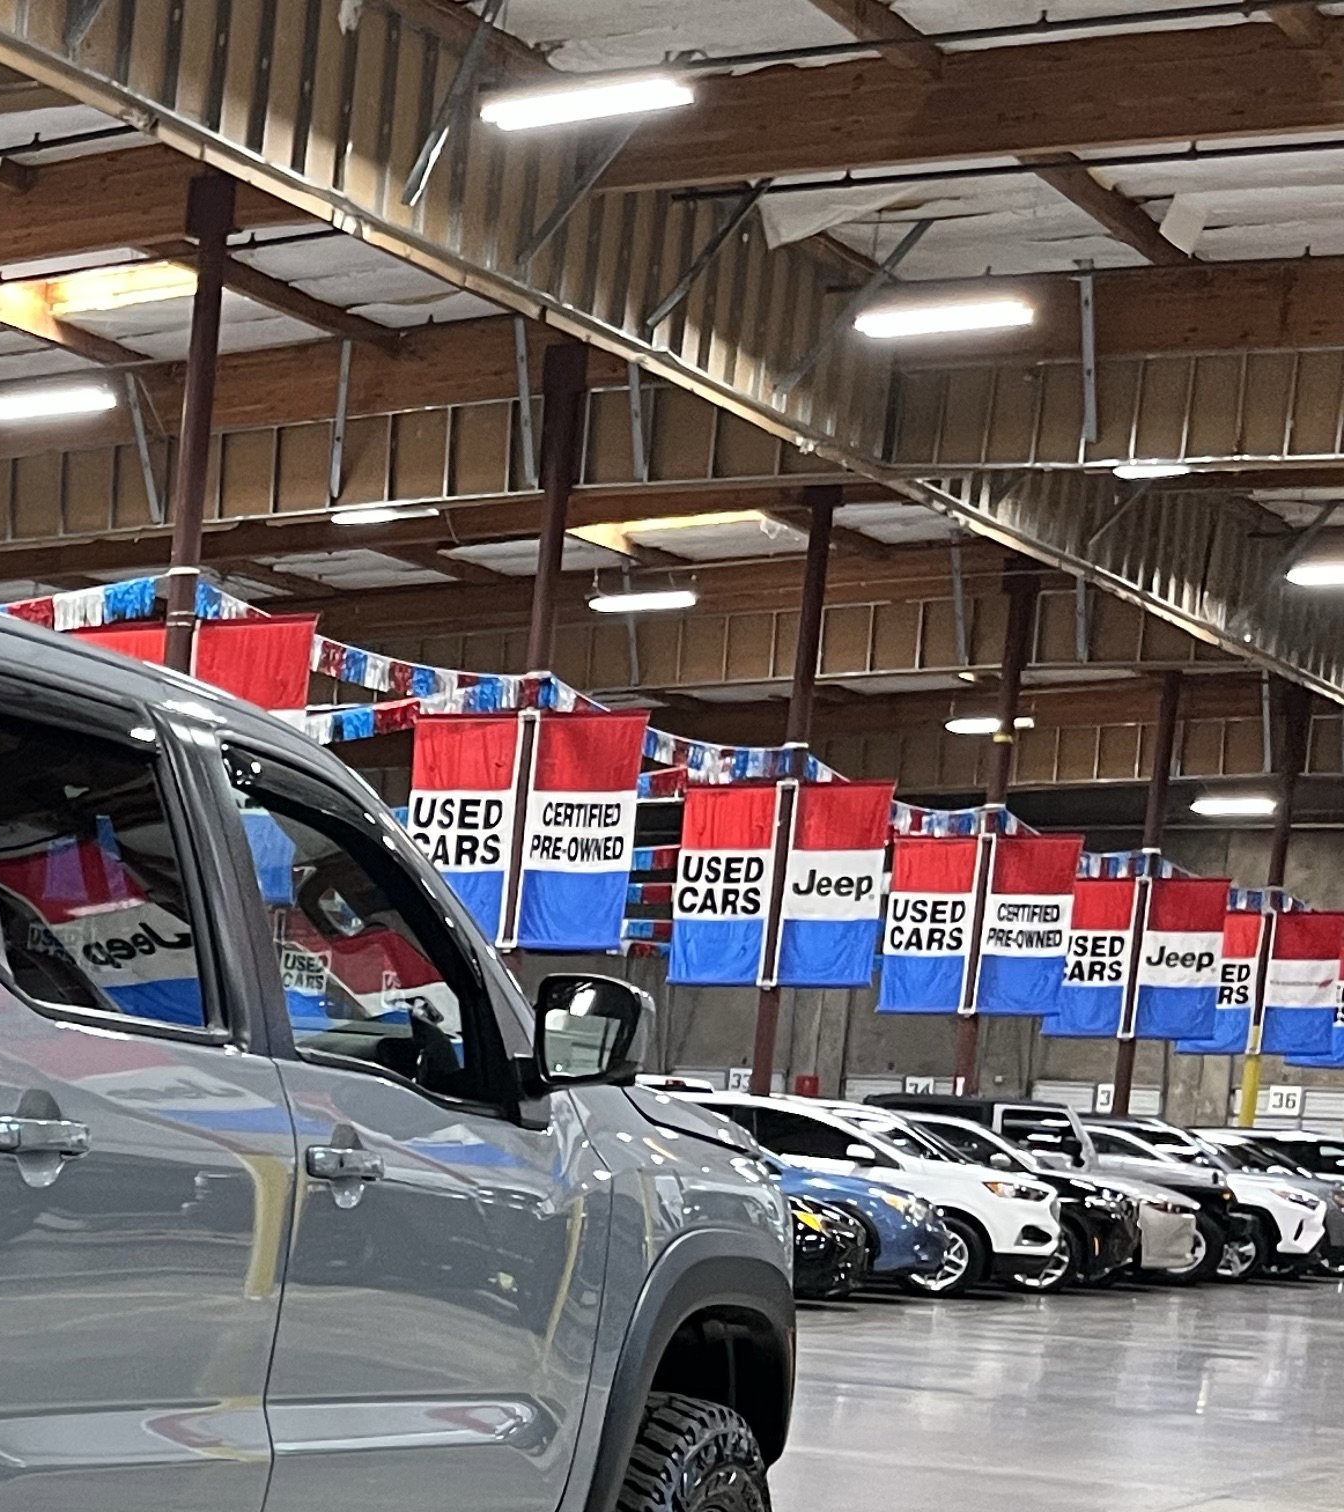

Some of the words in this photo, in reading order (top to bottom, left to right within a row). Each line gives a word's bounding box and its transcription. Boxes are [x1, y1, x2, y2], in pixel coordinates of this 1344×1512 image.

[413, 797, 503, 830] USED
[542, 802, 622, 827] CERTIFIED
[412, 832, 501, 866] CARS
[529, 834, 624, 862] PRE-OWNED
[682, 856, 764, 884] USED
[792, 869, 874, 901] Jeep
[677, 886, 761, 915] CARS
[892, 898, 966, 924] USED
[997, 903, 1061, 923] CERTIFIED
[890, 926, 963, 951] CARS
[986, 927, 1063, 949] PRE-OWNED
[284, 953, 329, 973] USED
[1064, 960, 1122, 982] ARS
[1146, 945, 1216, 973] Jeep
[1221, 963, 1251, 983] ED
[1219, 985, 1250, 1005] RS
[1272, 1092, 1297, 1109] 36
